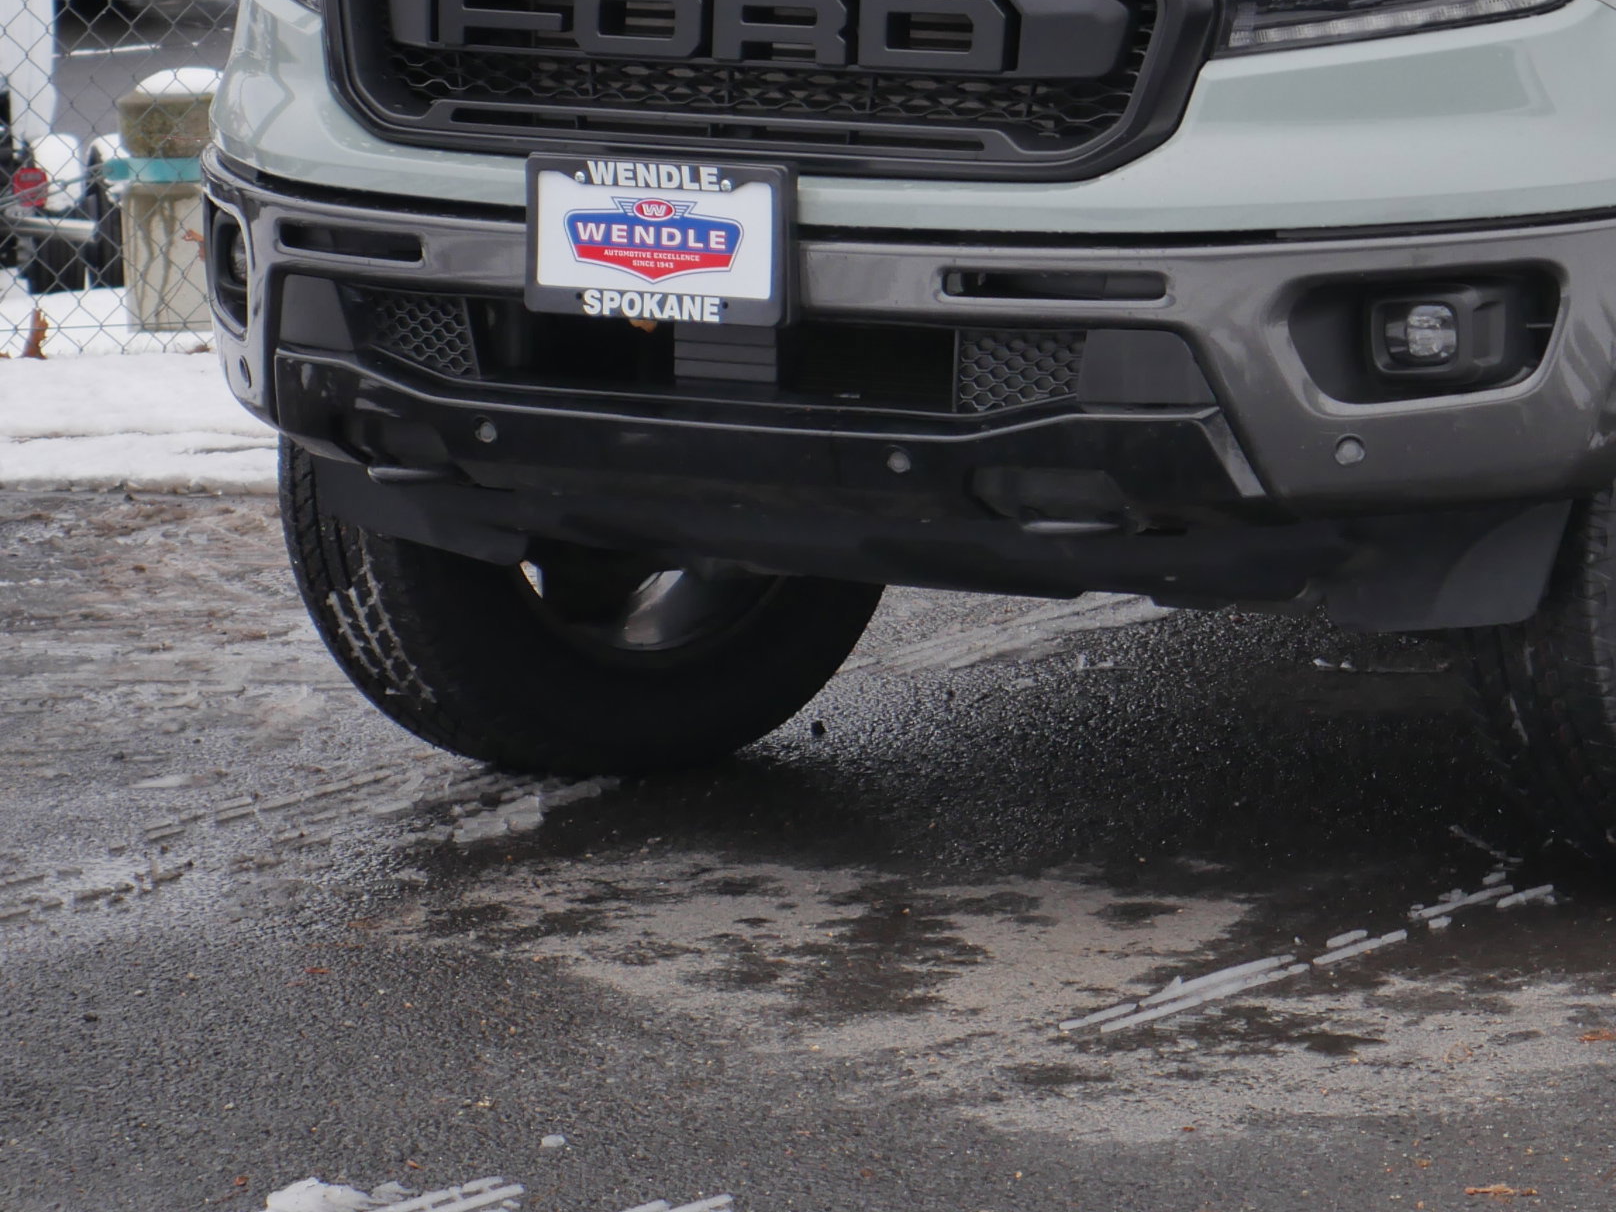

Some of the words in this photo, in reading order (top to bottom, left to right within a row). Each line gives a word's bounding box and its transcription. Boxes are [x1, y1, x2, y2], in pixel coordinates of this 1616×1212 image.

[586, 160, 720, 191] WENDLE
[576, 222, 726, 249] WENDLE
[604, 249, 652, 259] AUTOMOTIVE
[653, 252, 700, 262] EXCELLENCE
[632, 259, 655, 268] SINCE
[583, 289, 720, 323] SPOKANE
